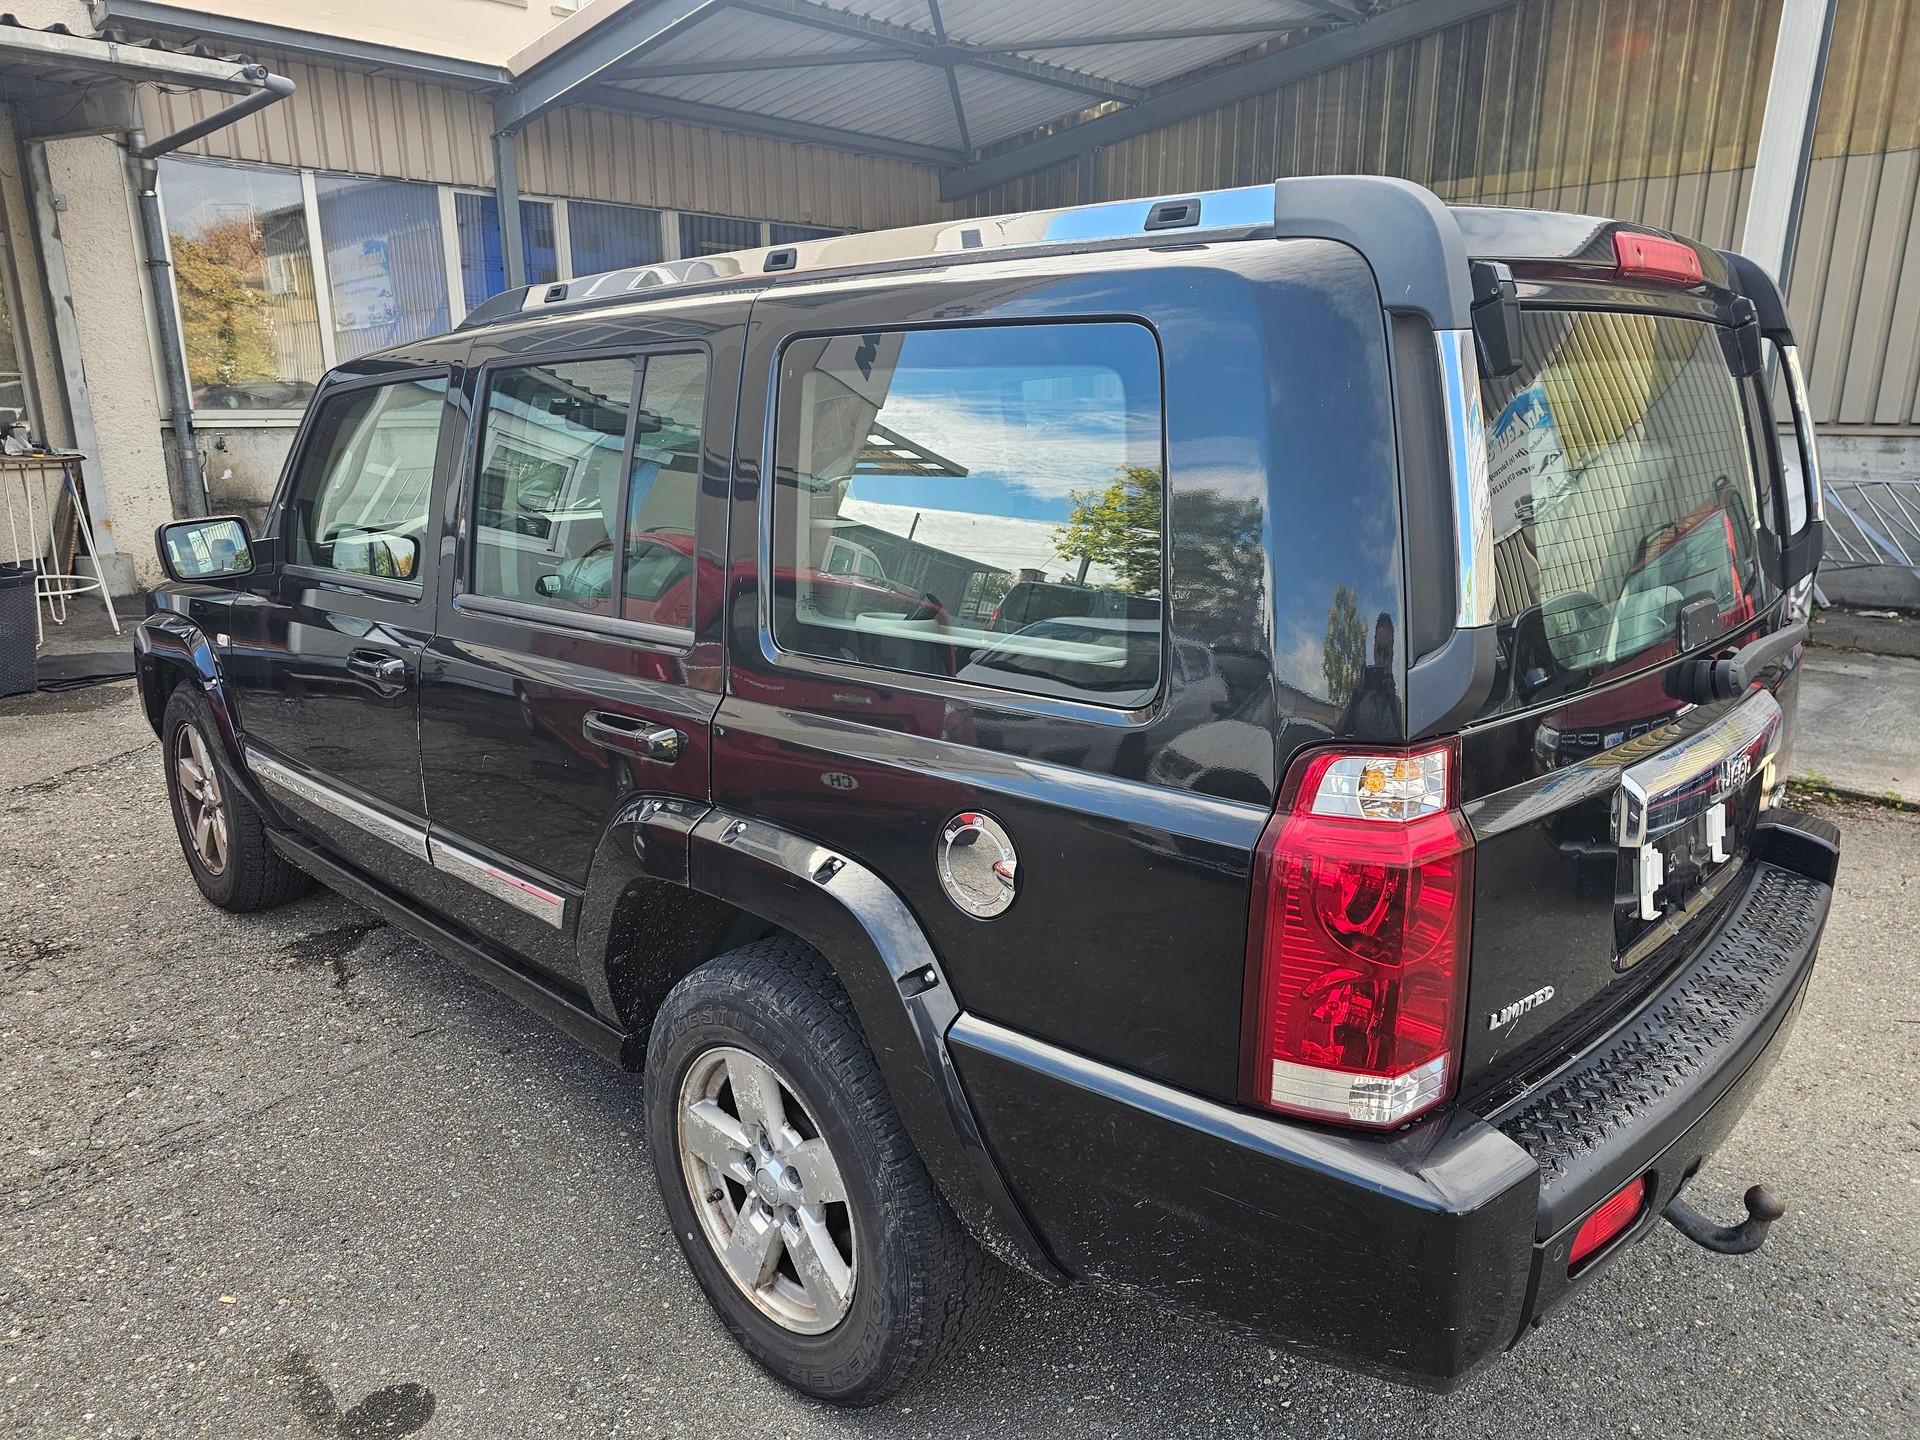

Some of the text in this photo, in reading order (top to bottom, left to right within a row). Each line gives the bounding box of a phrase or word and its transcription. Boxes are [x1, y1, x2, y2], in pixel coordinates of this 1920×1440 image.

[1716, 754, 1751, 793] Jeep
[1488, 985, 1555, 1031] LIMITED
[785, 1286, 885, 1388] DUELER
